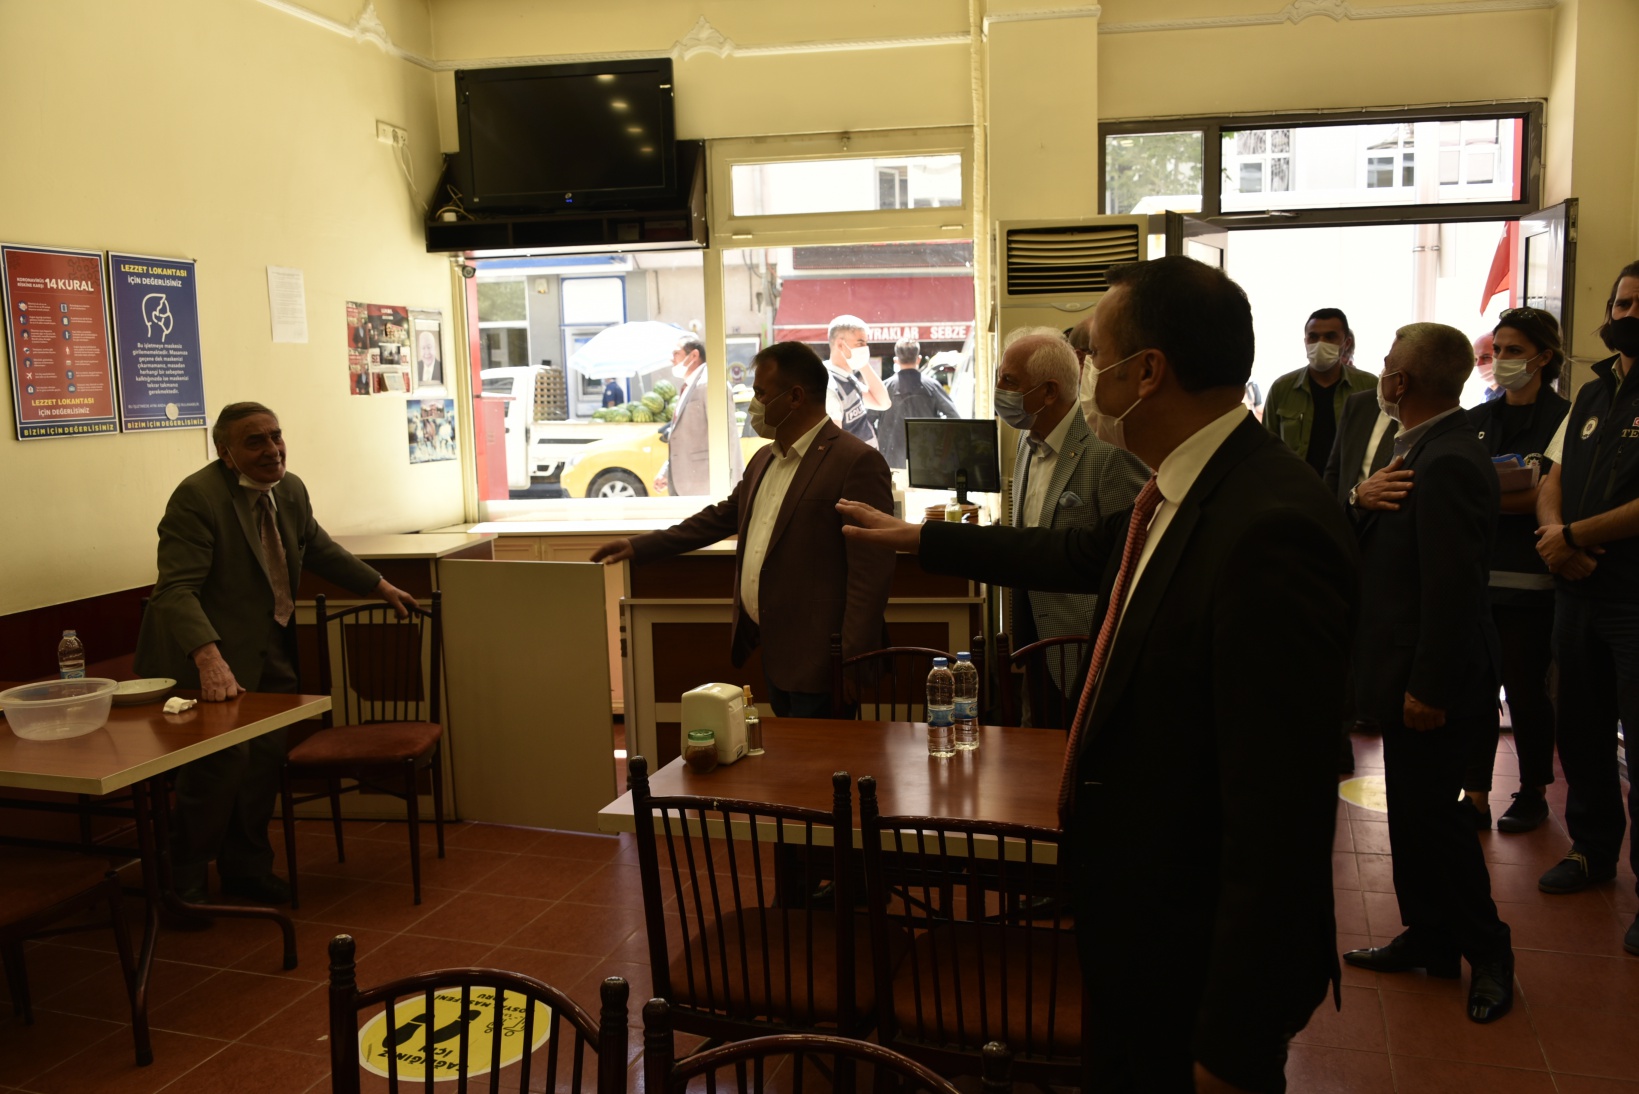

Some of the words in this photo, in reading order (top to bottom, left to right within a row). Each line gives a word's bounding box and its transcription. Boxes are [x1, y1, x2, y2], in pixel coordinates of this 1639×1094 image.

[121, 264, 147, 273] LEZZET
[149, 267, 187, 276] LOKANTASI
[45, 278, 57, 289] 14
[58, 279, 94, 291] KURAL
[128, 275, 141, 285] İÇİN
[142, 277, 182, 287] DEĞERLİSİNİZ
[868, 326, 919, 340] YRAKLAR
[930, 326, 966, 339] SEBZE
[38, 409, 50, 417] İÇİN
[162, 418, 204, 427] DEĞERLİSİNİZ
[47, 427, 62, 435] İÇİN
[65, 424, 114, 433] DEĞERLİSİNİZ
[1621, 428, 1639, 438] TE
